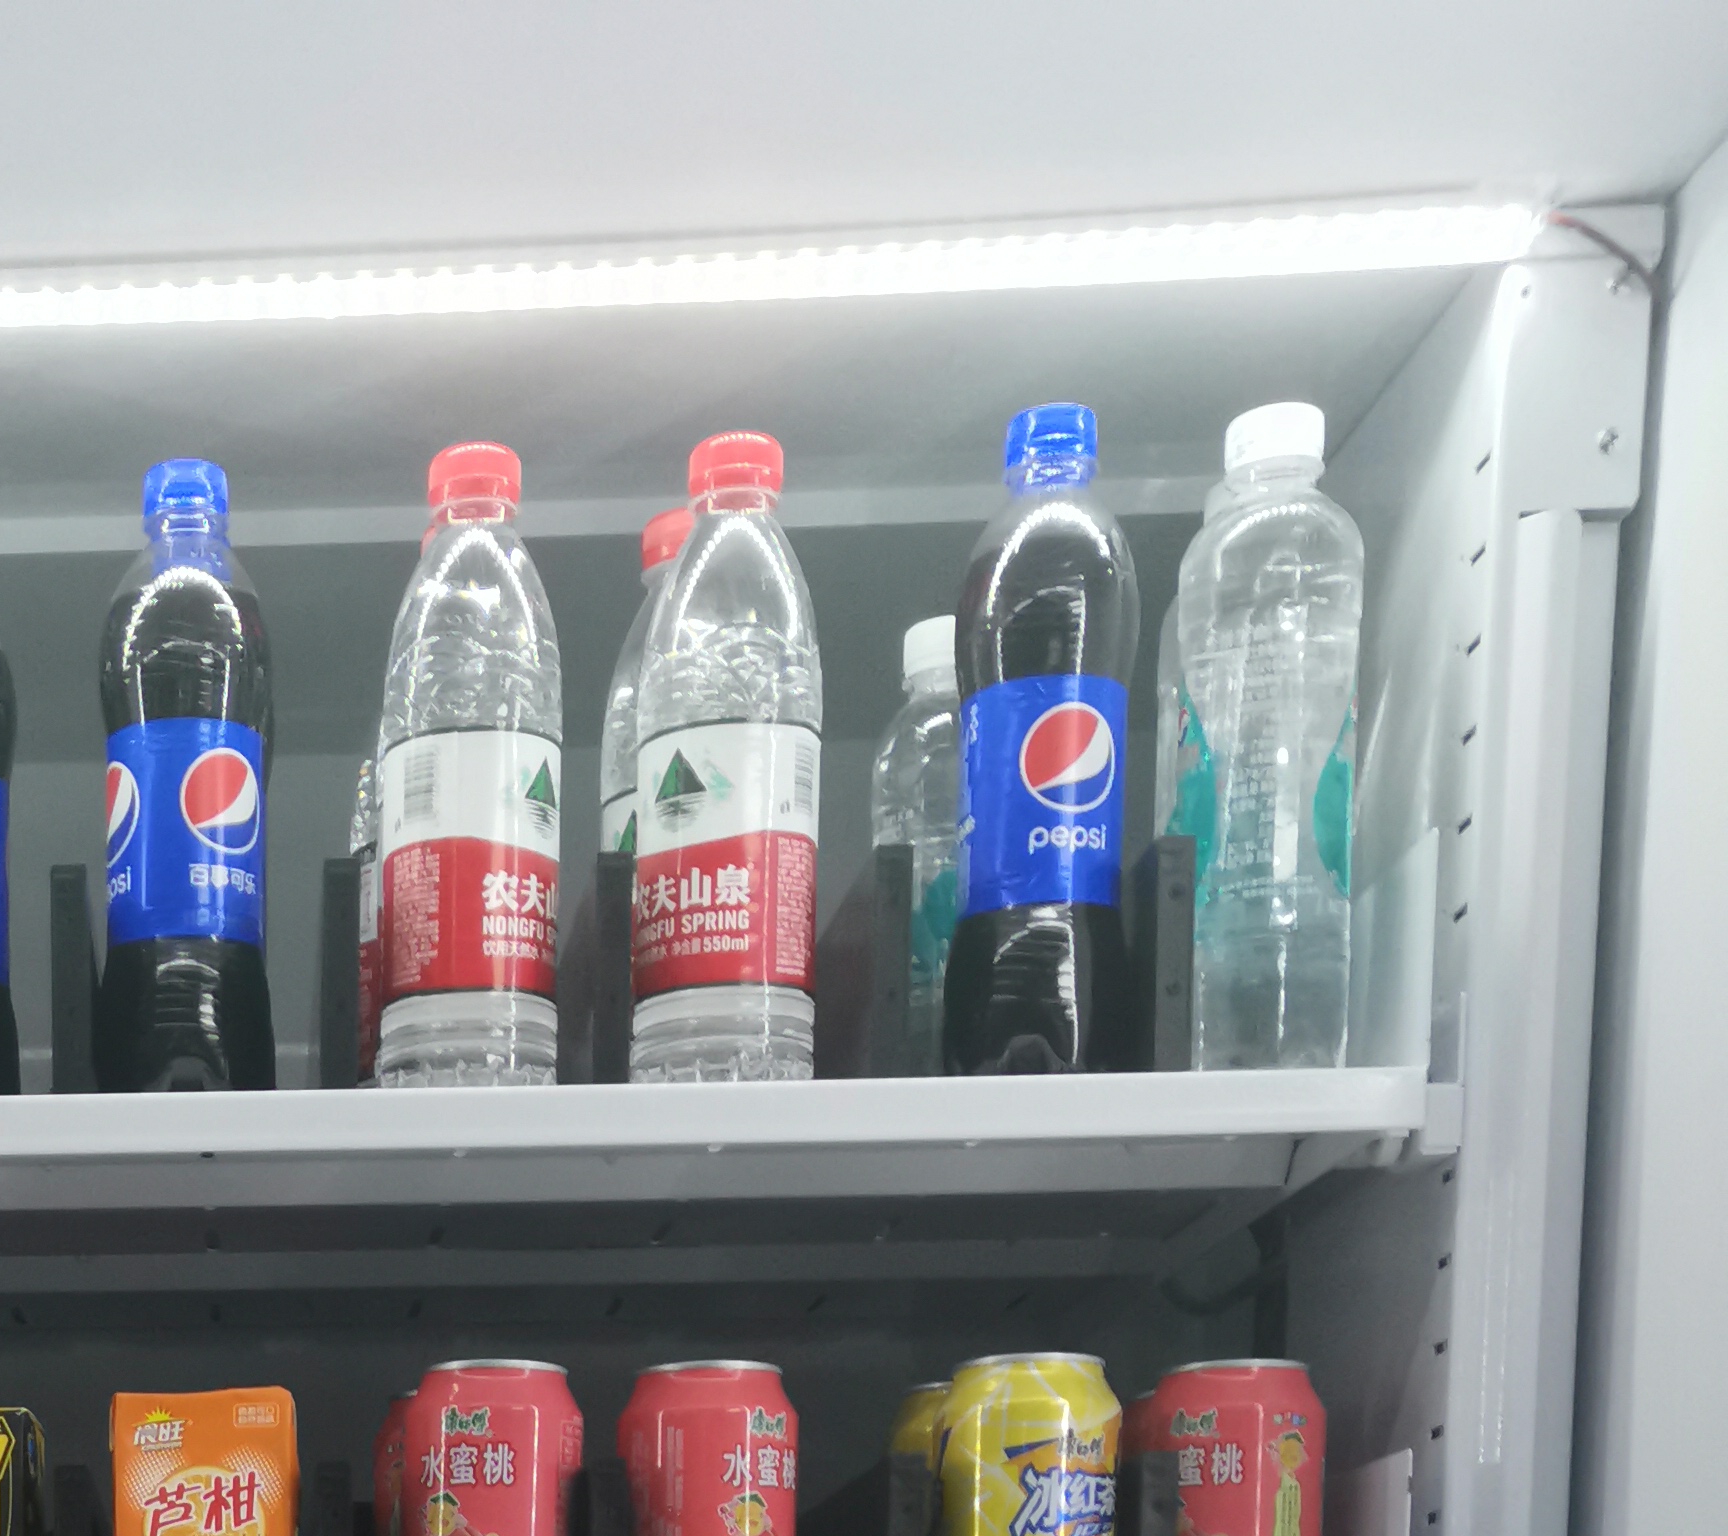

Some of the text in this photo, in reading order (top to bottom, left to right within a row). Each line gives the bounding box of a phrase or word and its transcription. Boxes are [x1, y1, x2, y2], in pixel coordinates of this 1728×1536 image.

[1029, 823, 1107, 856] pepsi
[482, 915, 545, 941] NONGFU
[680, 909, 750, 935] SPRING
[420, 1442, 516, 1487] 水蜜桃
[1177, 1442, 1245, 1488] 蜜桃
